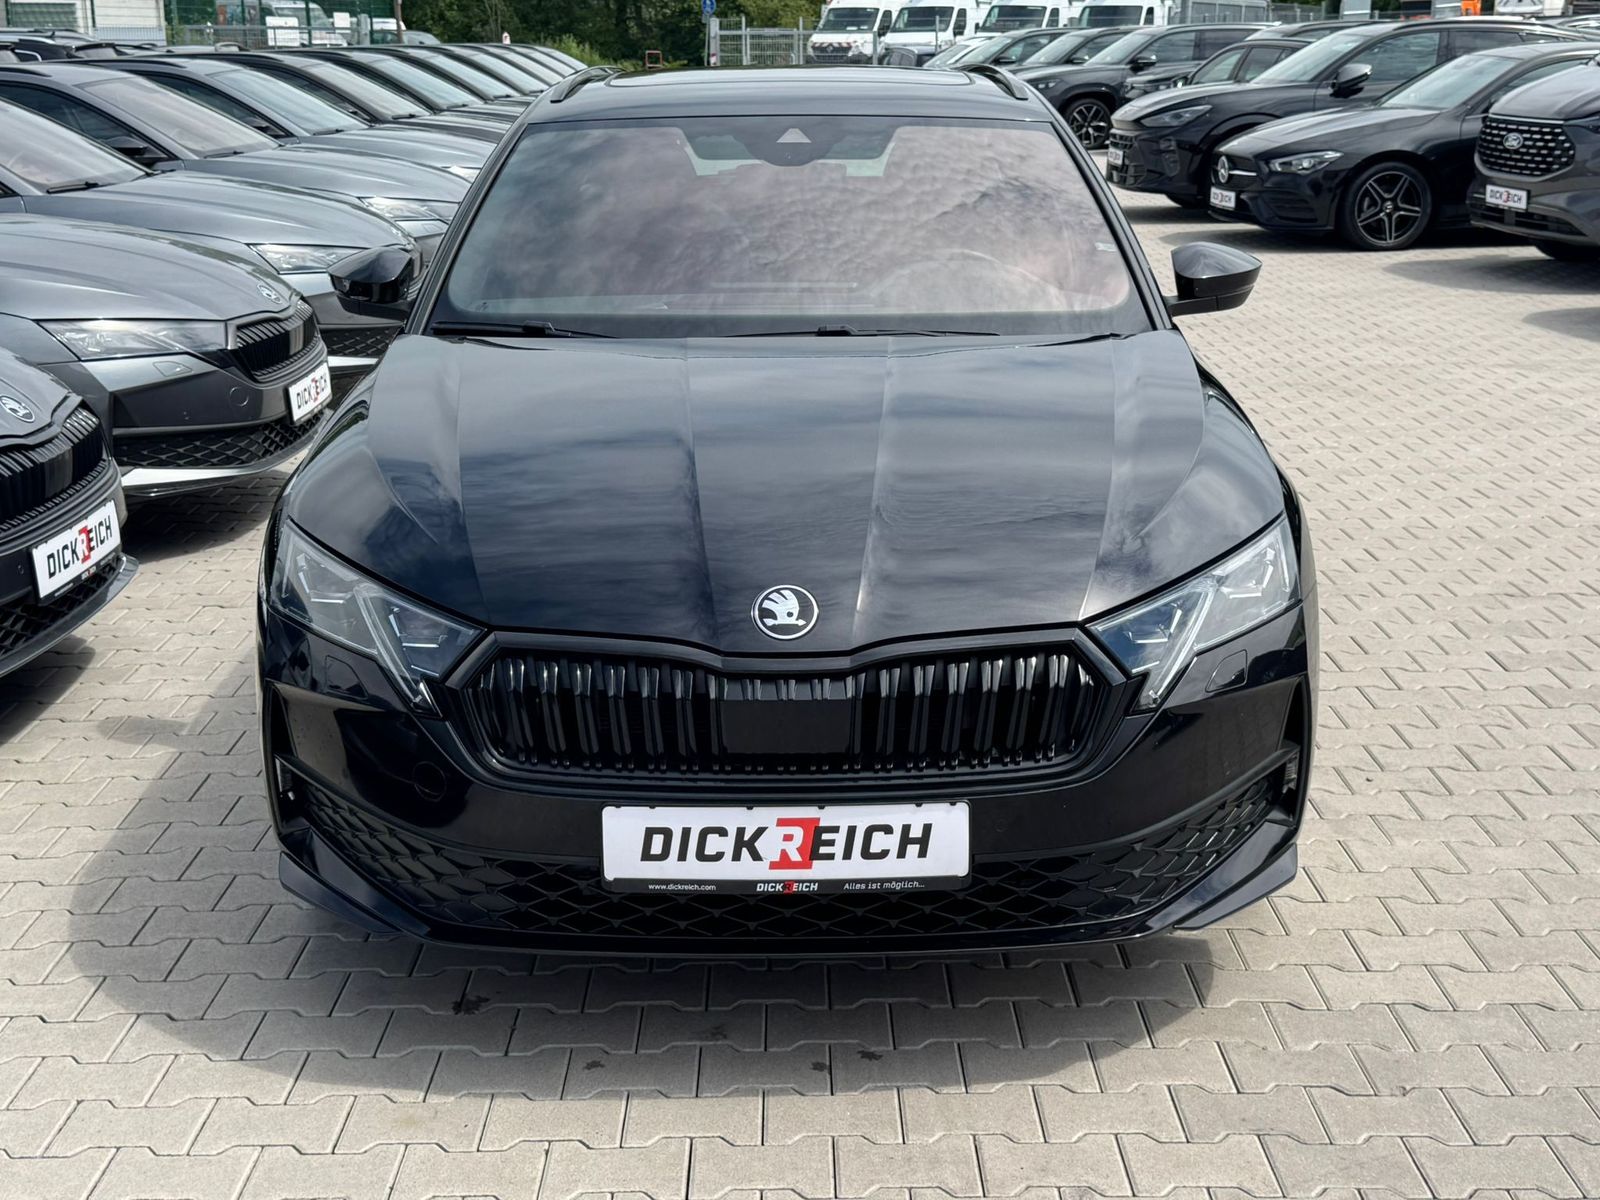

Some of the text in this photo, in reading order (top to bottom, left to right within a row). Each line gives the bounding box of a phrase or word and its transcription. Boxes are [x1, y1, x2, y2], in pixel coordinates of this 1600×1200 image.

[46, 515, 113, 579] DICKREICH
[640, 817, 933, 870] DICKREICH
[648, 883, 717, 892] www.dickreich.com
[756, 880, 819, 894] DICKREICH
[843, 882, 866, 890] Alles
[868, 881, 881, 890] ist
